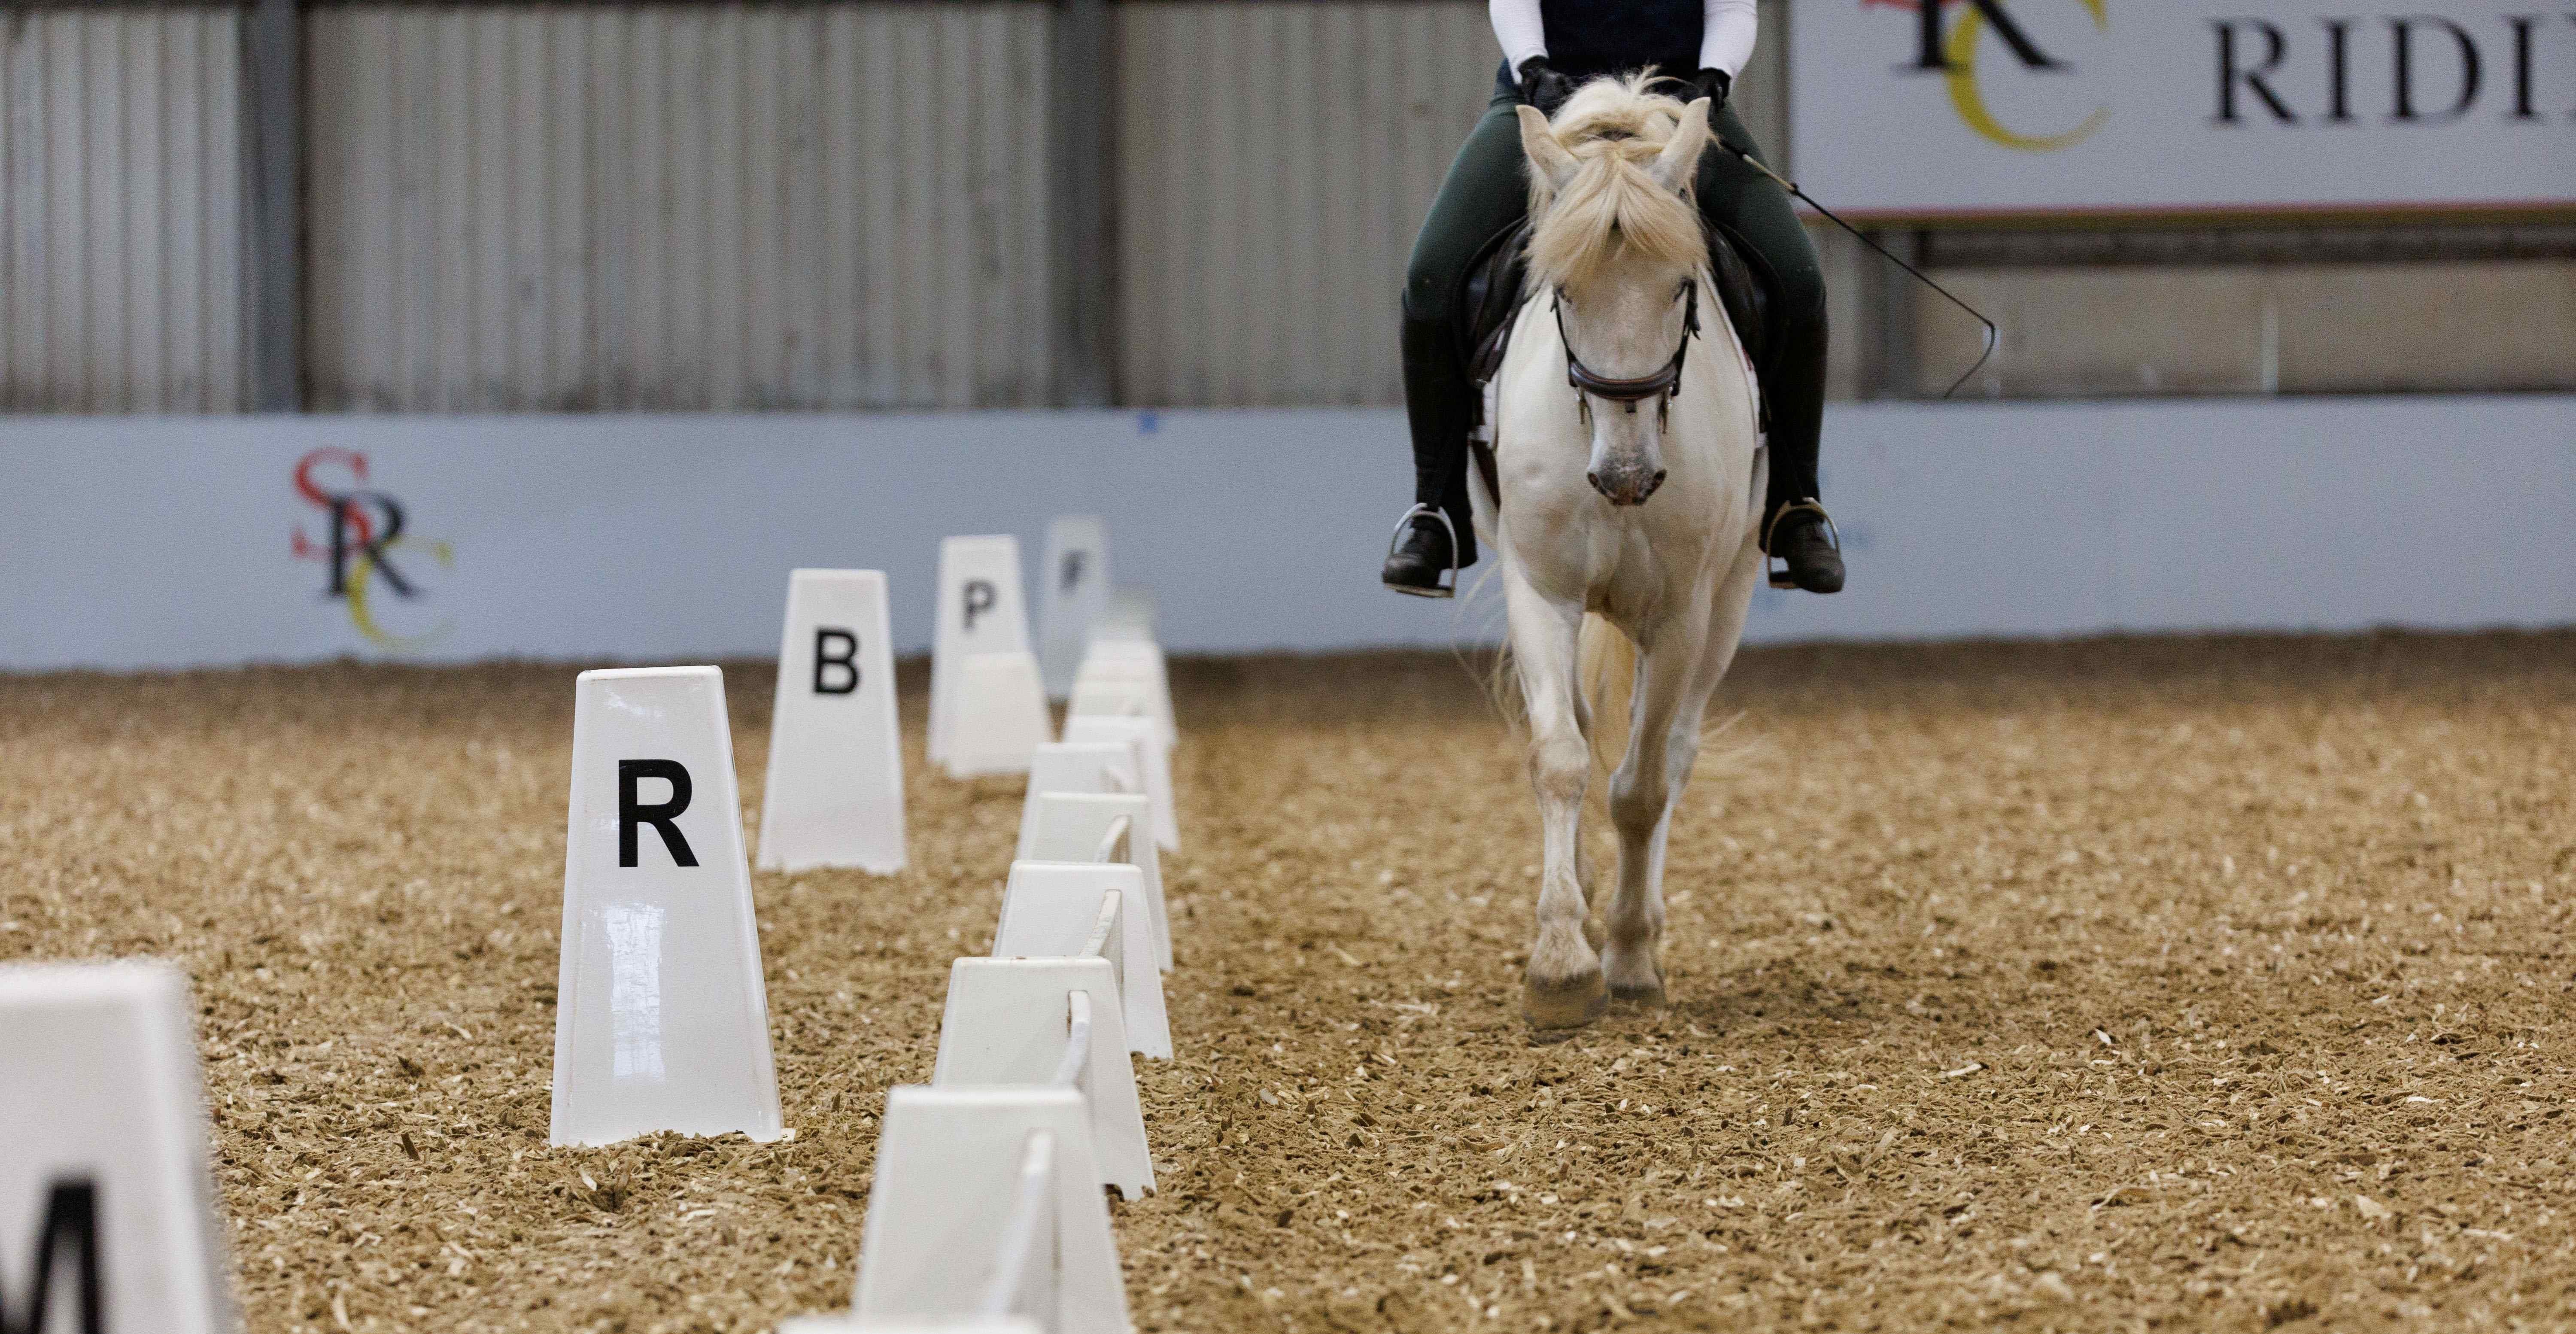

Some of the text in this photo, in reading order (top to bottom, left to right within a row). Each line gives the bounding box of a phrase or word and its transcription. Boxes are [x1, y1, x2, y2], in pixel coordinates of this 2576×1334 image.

[2211, 17, 2576, 125] RIDI
[961, 578, 998, 630] P
[813, 627, 859, 695] B
[618, 759, 700, 867] R
